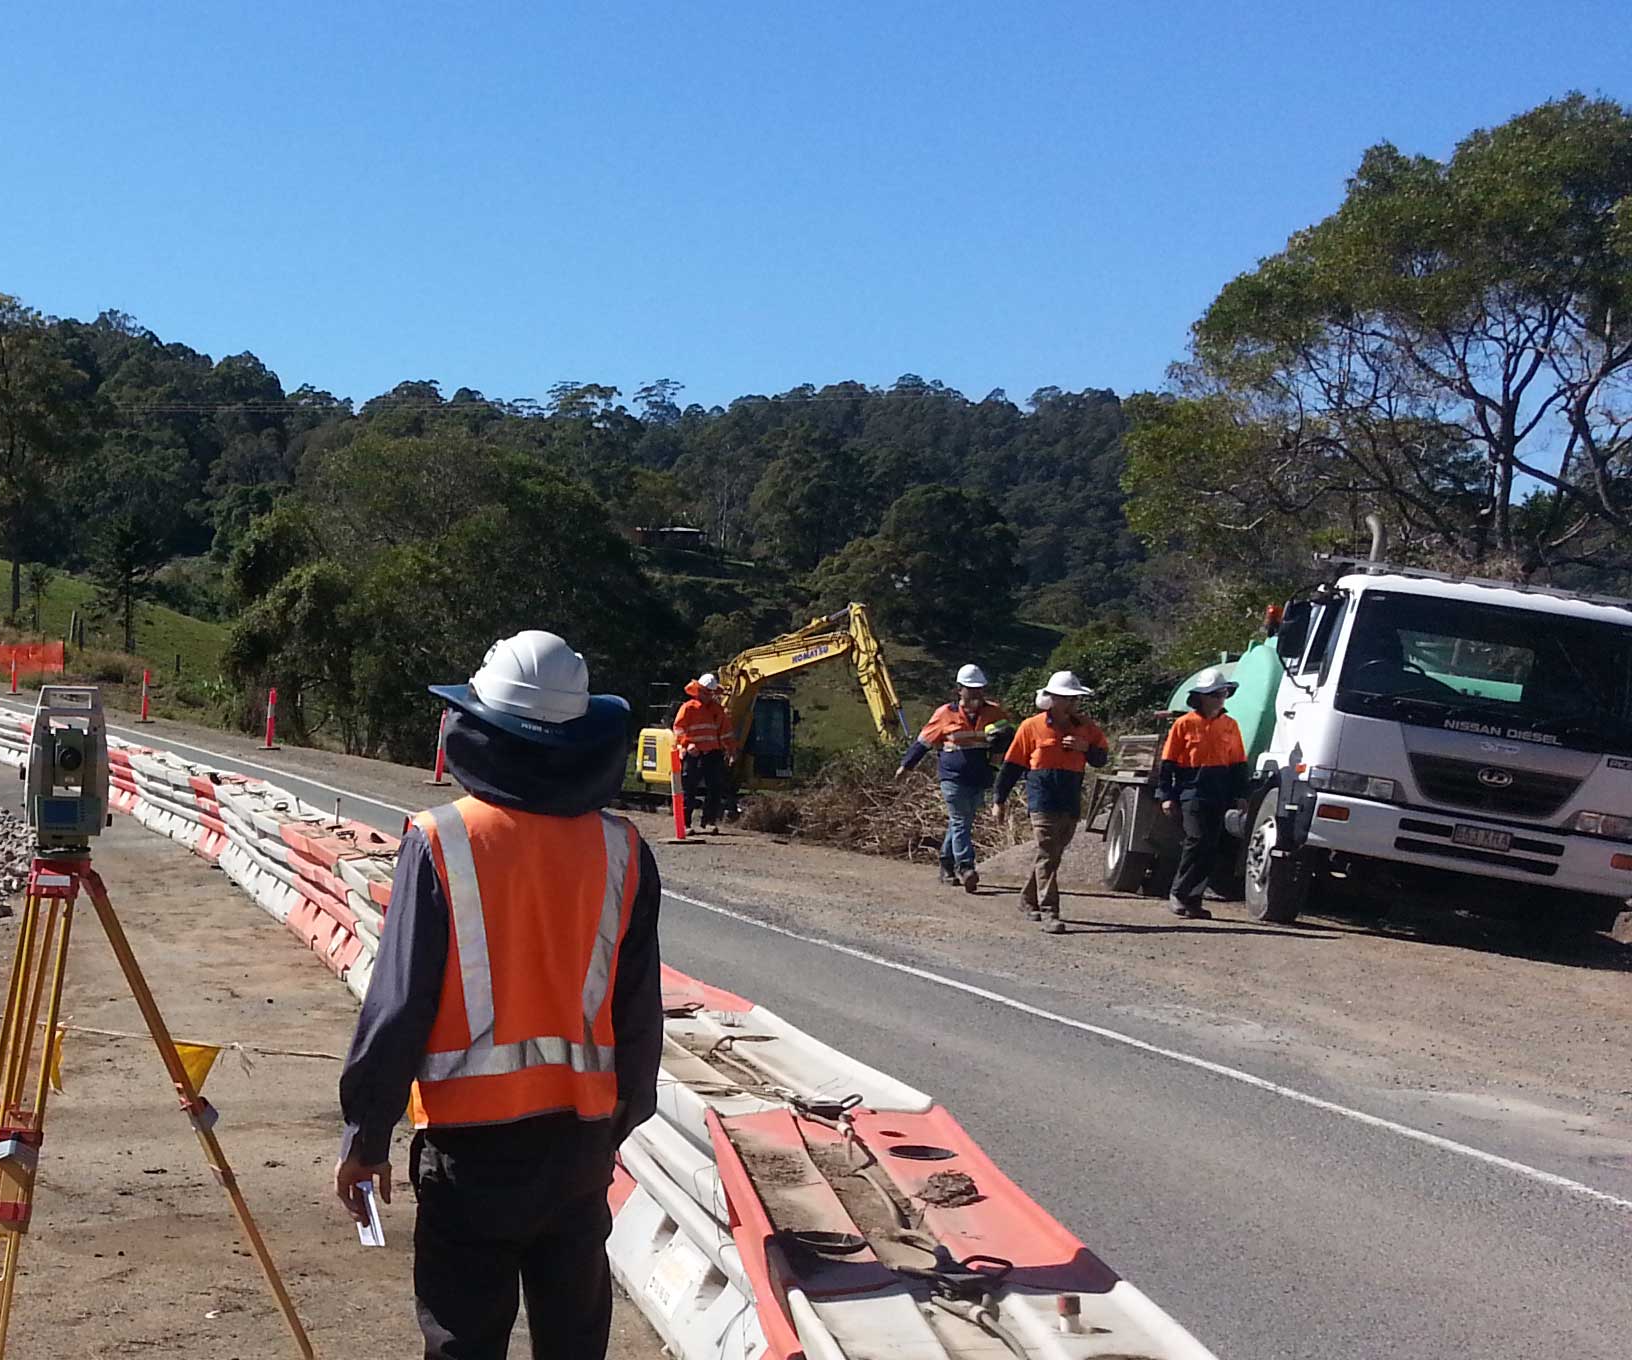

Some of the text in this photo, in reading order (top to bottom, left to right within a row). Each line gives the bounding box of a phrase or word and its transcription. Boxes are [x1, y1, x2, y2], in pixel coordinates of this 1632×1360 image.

[791, 645, 828, 663] KOMATSU
[1443, 719, 1563, 746] NISSAN DIESEL
